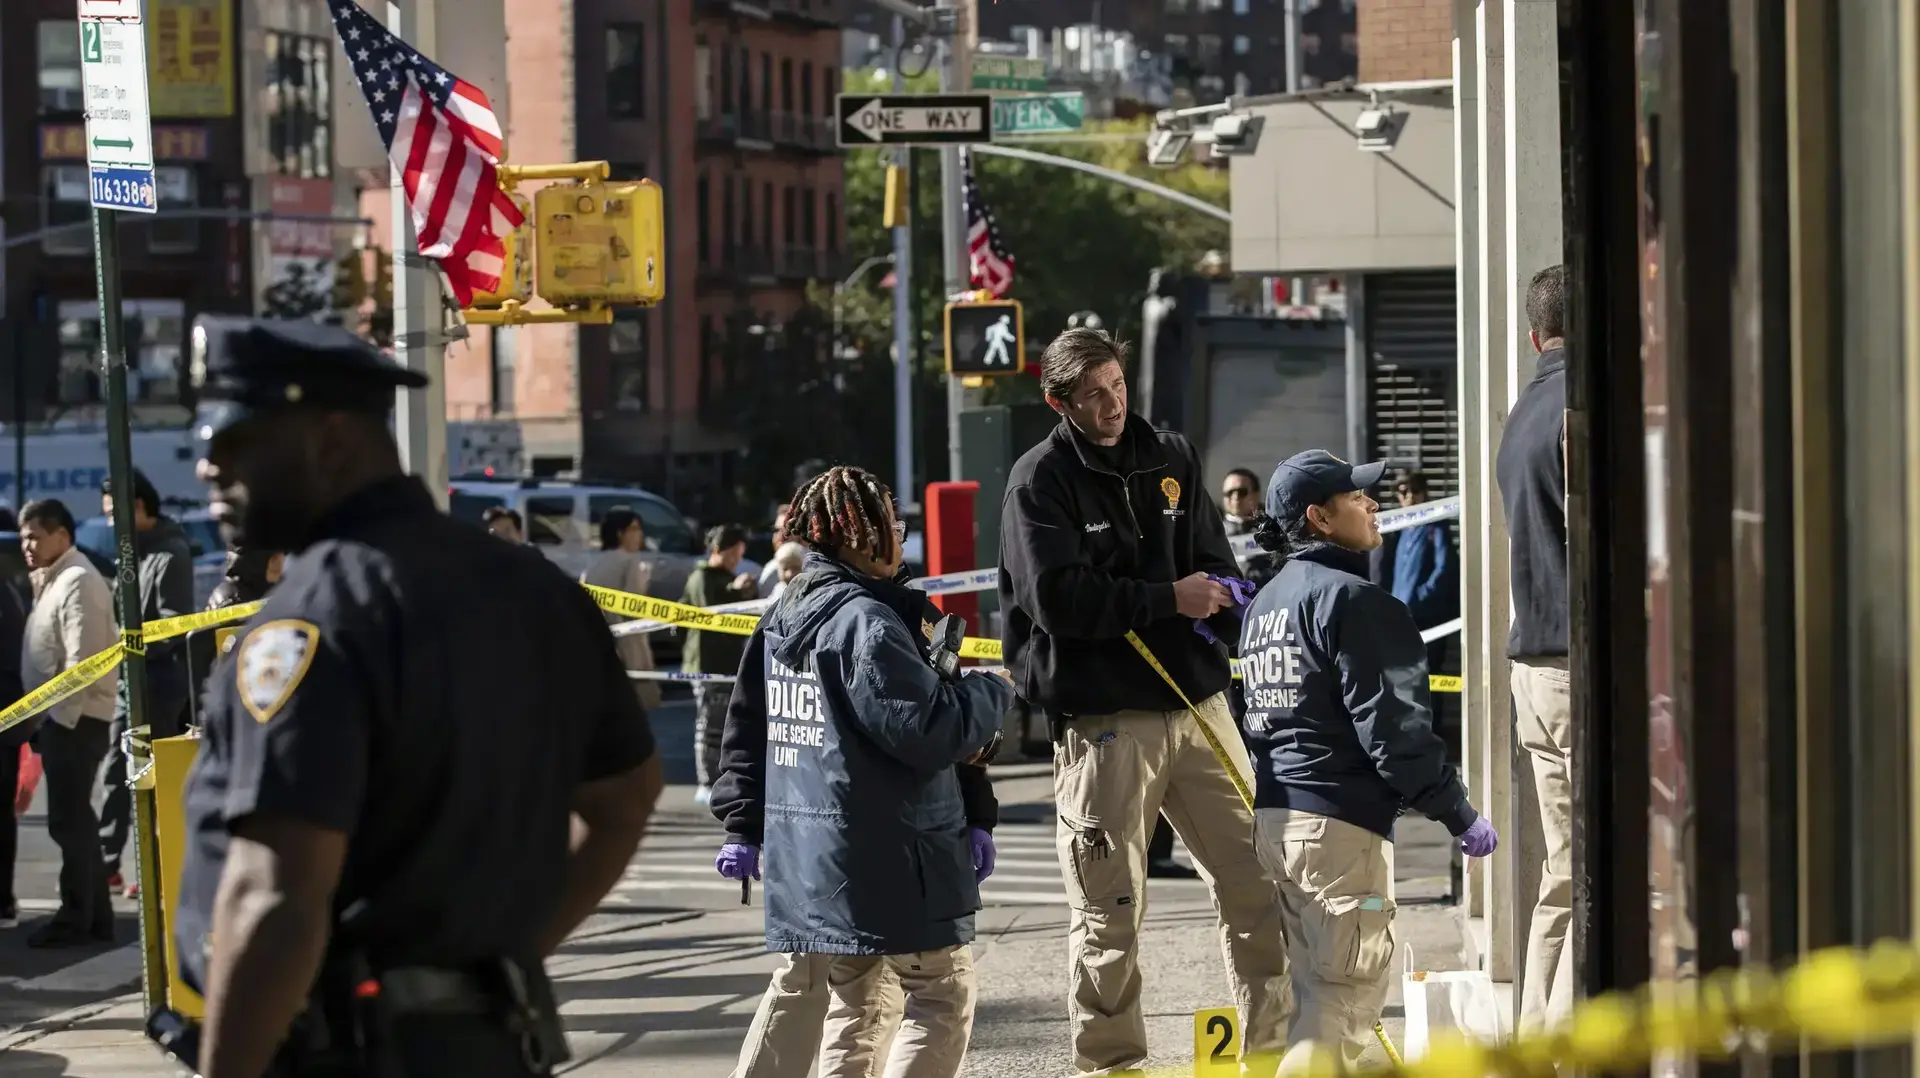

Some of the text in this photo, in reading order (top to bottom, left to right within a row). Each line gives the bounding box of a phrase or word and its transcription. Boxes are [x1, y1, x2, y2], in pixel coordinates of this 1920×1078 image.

[86, 22, 99, 59] 2
[861, 109, 971, 130] ONE WAY
[93, 177, 139, 204] 116338
[1254, 688, 1299, 708] SCENE
[790, 724, 825, 747] SCENE
[1206, 1015, 1237, 1066] 2
